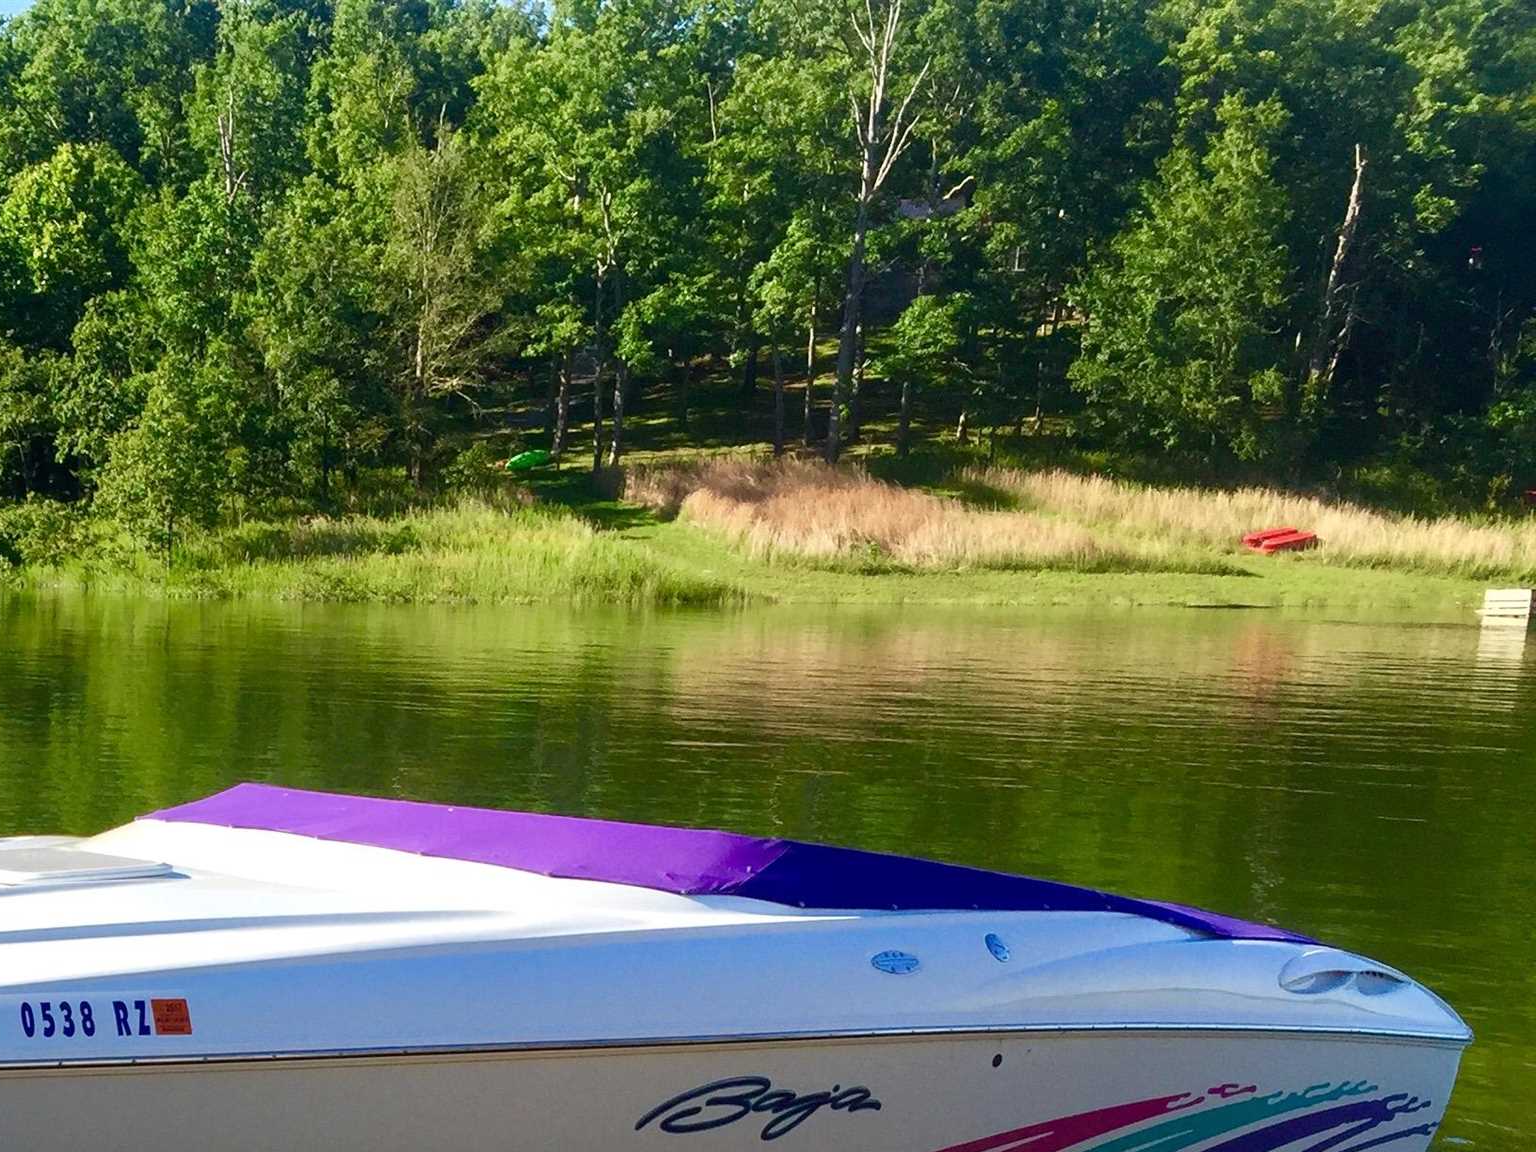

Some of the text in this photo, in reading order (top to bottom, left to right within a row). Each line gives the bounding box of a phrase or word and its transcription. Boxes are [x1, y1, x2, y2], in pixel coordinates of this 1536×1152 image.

[20, 1000, 96, 1038] 0538
[112, 999, 151, 1036] RZ
[634, 1075, 882, 1141] Baja
